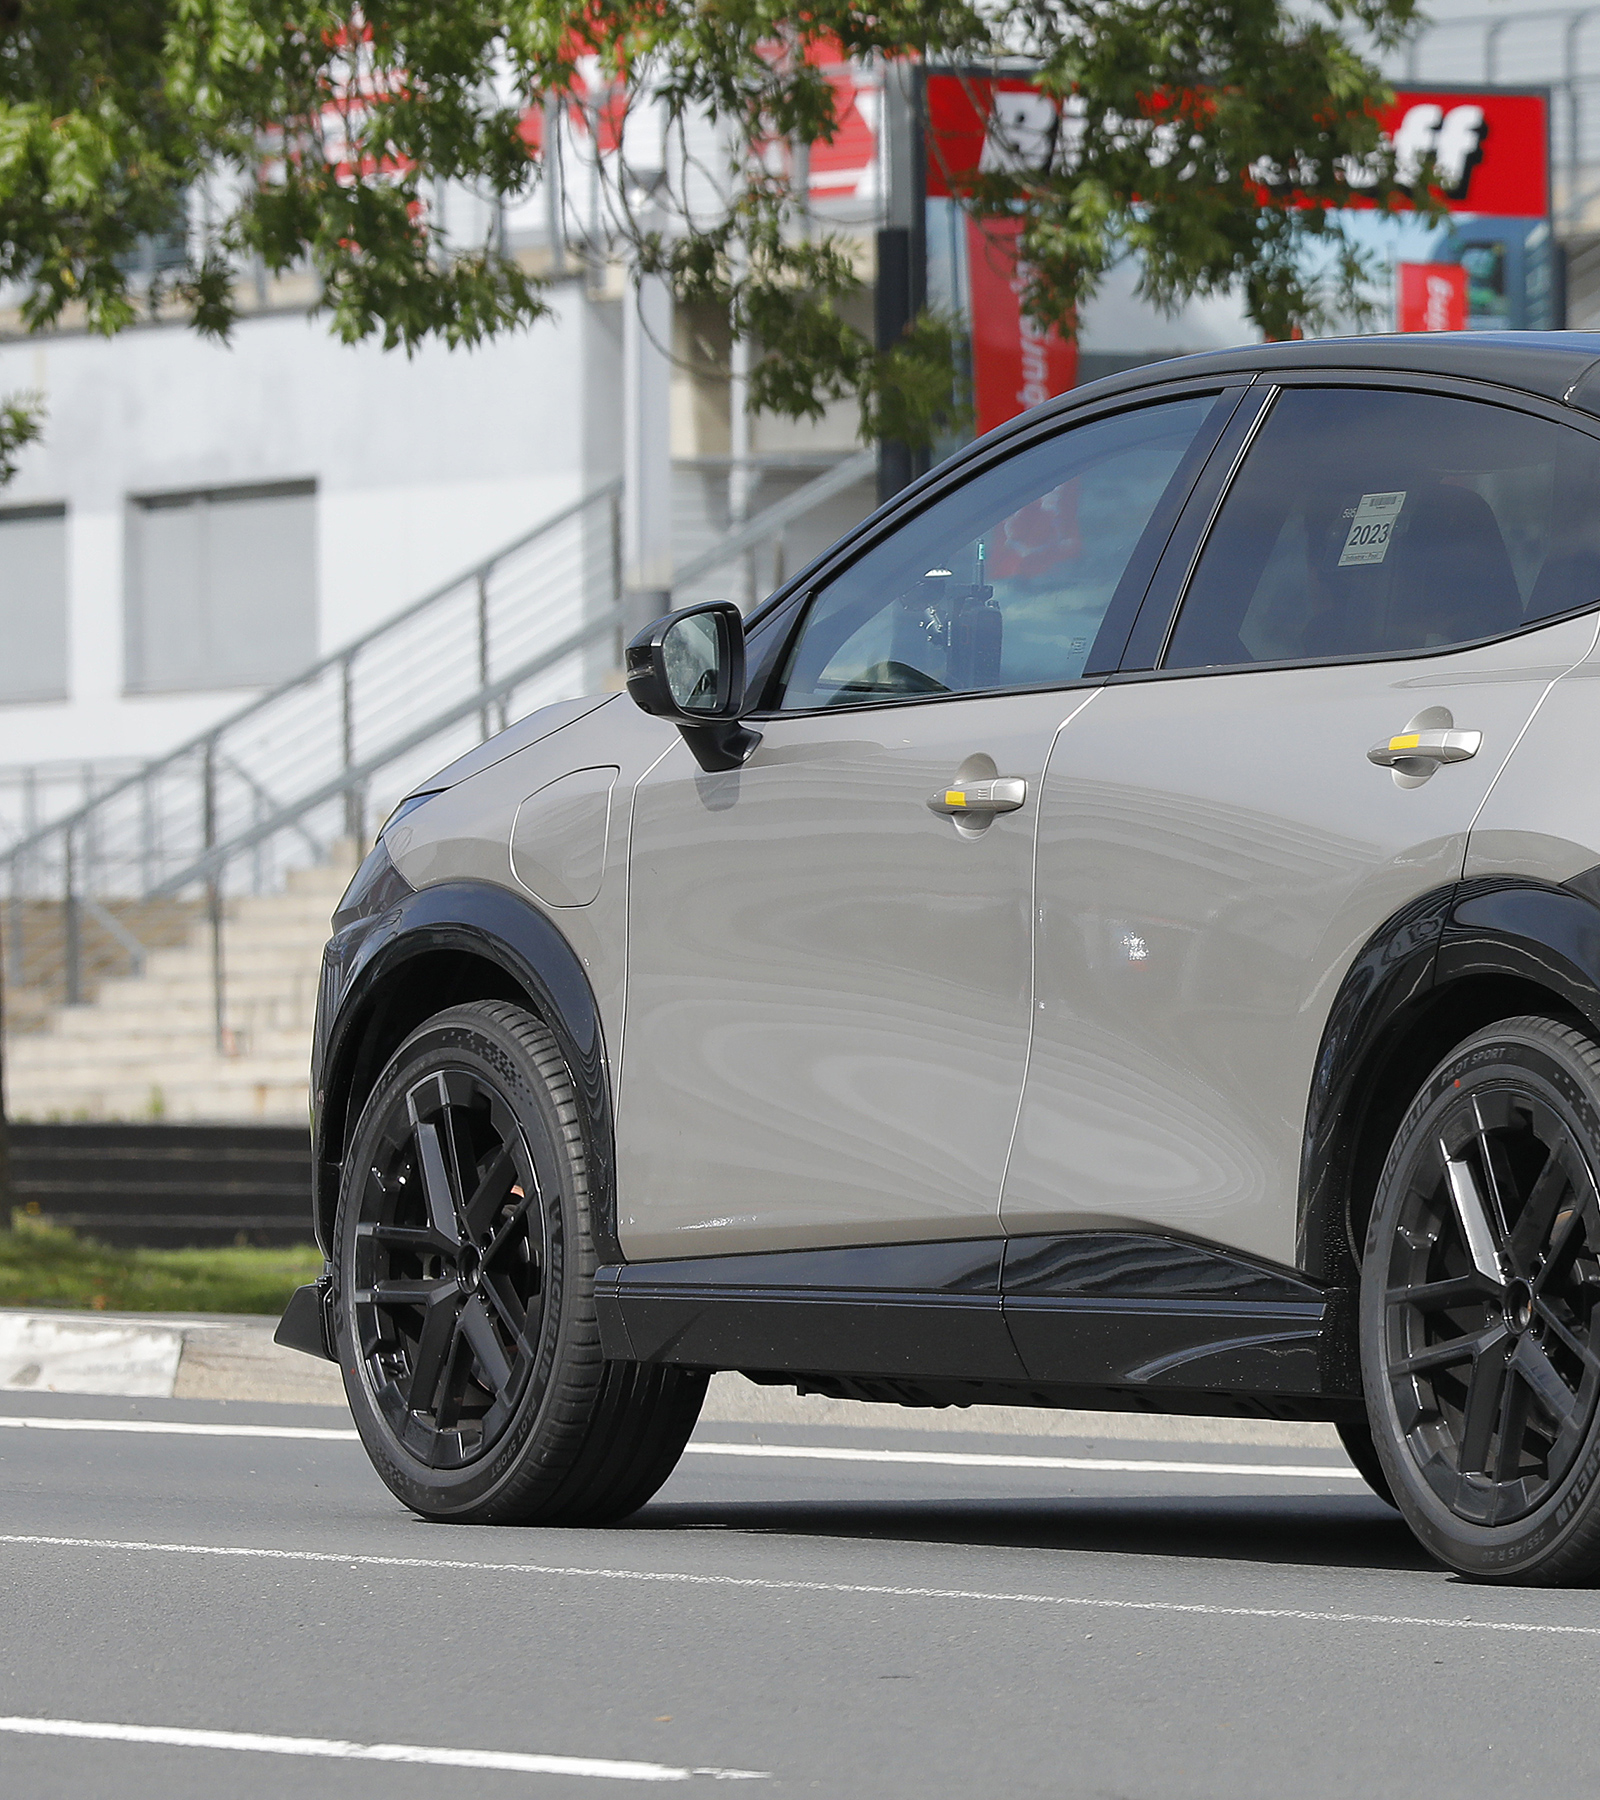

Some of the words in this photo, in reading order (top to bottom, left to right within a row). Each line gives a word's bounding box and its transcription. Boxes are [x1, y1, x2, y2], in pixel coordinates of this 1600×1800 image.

[1348, 523, 1390, 546] 2023
[1441, 1057, 1470, 1086] PILOT
[1471, 1047, 1506, 1065] SPORT
[490, 1440, 517, 1478] SPORT
